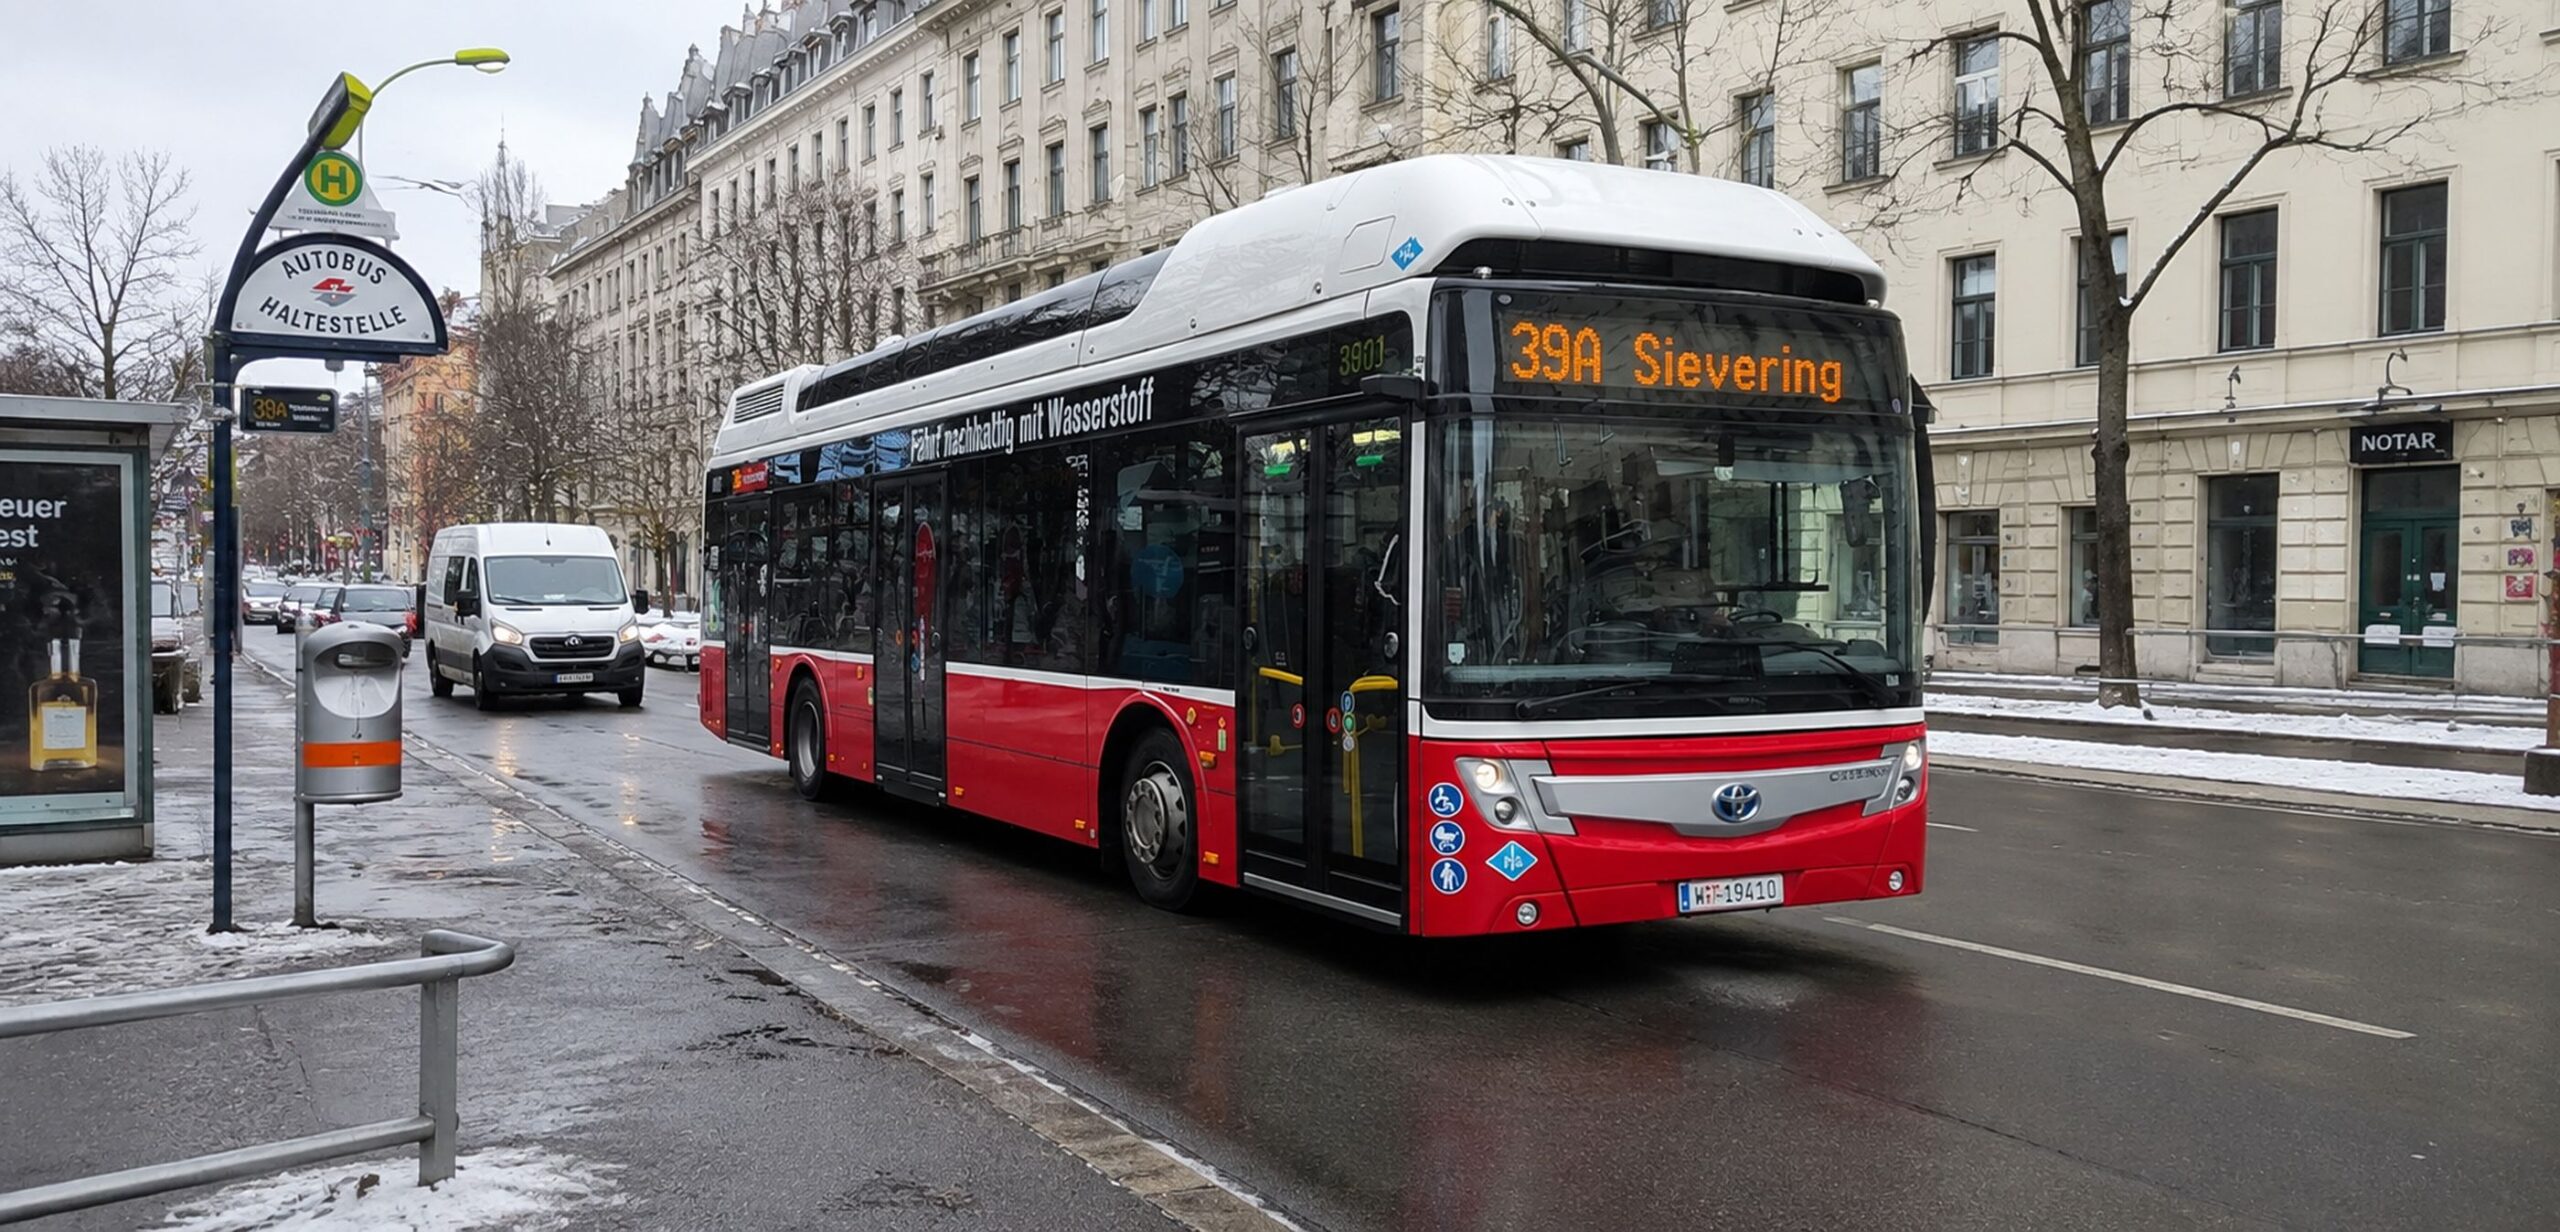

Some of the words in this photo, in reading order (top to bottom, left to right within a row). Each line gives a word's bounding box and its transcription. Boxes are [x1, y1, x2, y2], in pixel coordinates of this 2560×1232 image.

[281, 250, 387, 285] AUTOBUS
[259, 296, 407, 335] HALTESTELLE
[1512, 321, 1601, 384] 39A
[1633, 331, 1842, 403] Sievering
[1019, 402, 1044, 444] mit
[1047, 376, 1154, 438] Wasserstoff
[2361, 432, 2436, 452] NOTAR
